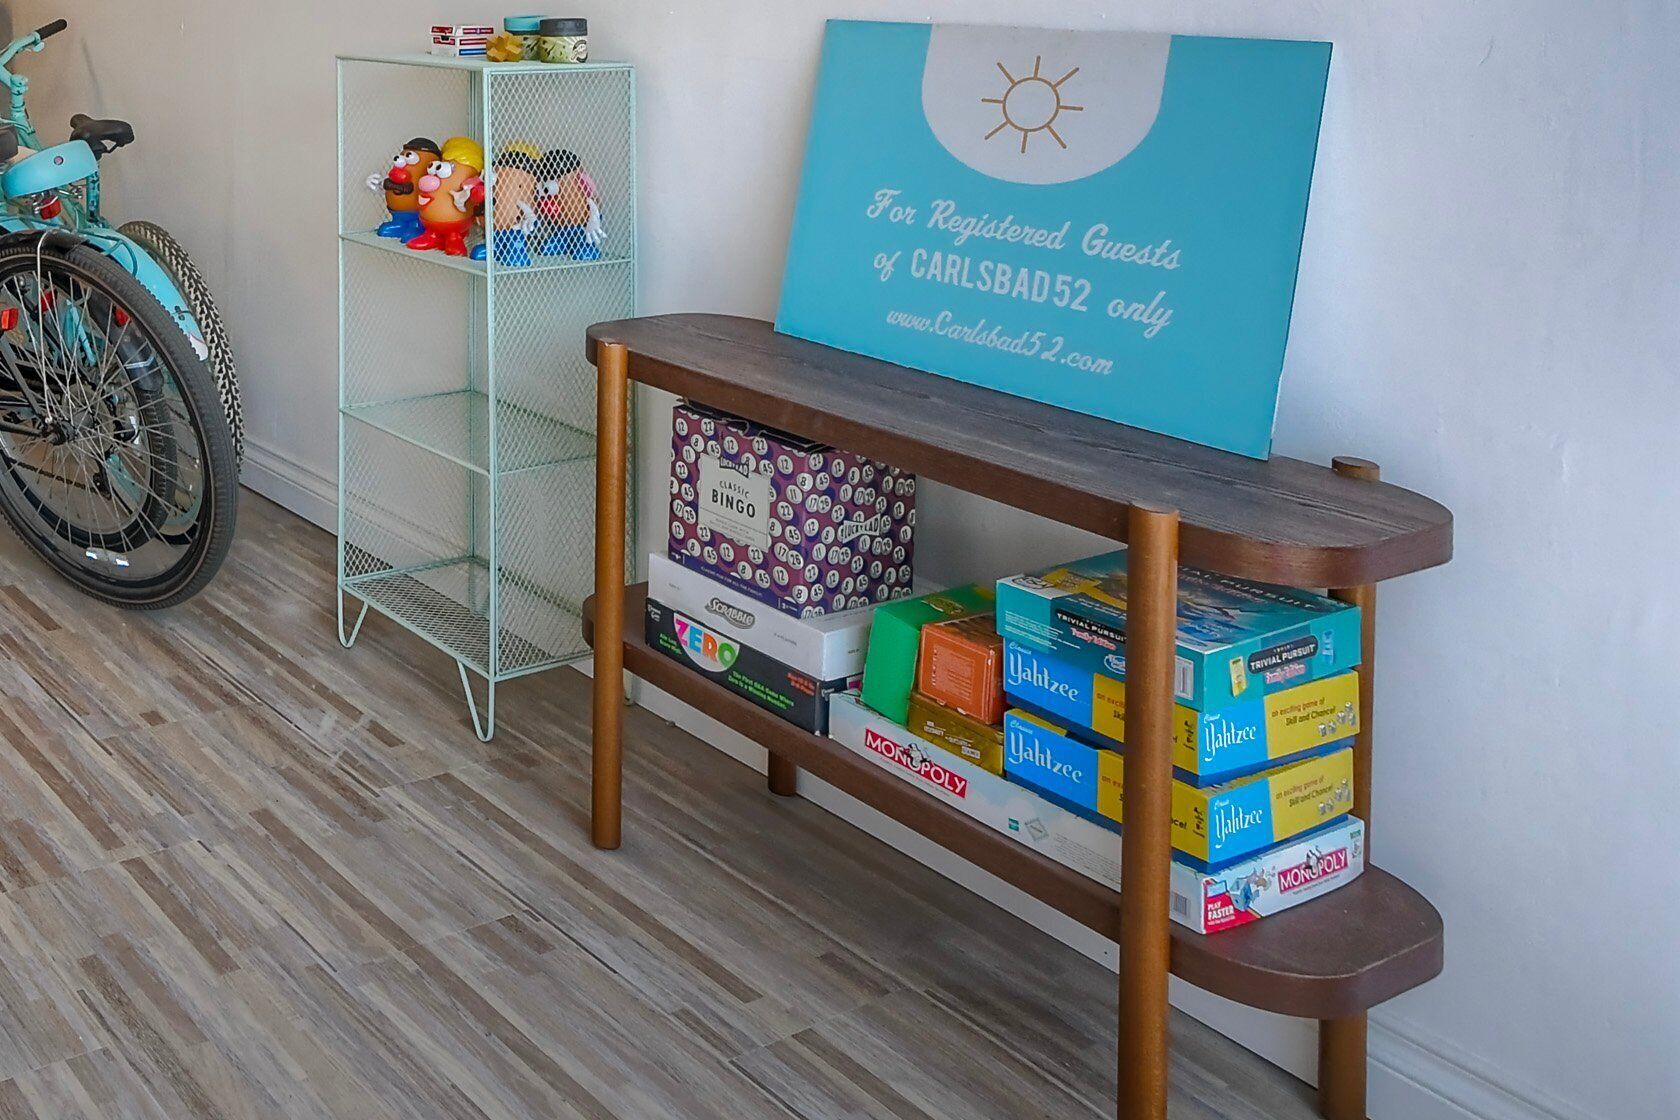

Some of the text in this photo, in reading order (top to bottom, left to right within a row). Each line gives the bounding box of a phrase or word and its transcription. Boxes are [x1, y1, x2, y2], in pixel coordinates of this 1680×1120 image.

[867, 188, 1181, 270] For Registered Guests
[873, 251, 902, 282] of
[1107, 290, 1174, 339] only
[886, 310, 1114, 375] www.Carlsbad52.com
[712, 489, 755, 518] BINGO
[720, 481, 750, 498] CLASSIC
[1057, 612, 1089, 630] TRIVIAL
[675, 618, 736, 668] ZERO
[1250, 656, 1281, 670] TRIVIAL
[1282, 644, 1316, 661] PURSUIT
[1008, 653, 1079, 702] Yahtzee
[1280, 705, 1302, 715] exciting
[1302, 700, 1318, 711] game
[1319, 696, 1325, 705] of
[1286, 706, 1336, 726] Skill and Chance!
[1008, 730, 1082, 784] Yahtzee
[1204, 719, 1256, 762] Yahtzee
[866, 731, 966, 794] MONOPOLY
[1283, 785, 1302, 796] exciting
[1304, 779, 1318, 790] game
[1301, 792, 1311, 802] and
[1215, 804, 1262, 849] Yahtzee
[1280, 849, 1346, 891] MONOPOLY
[1207, 901, 1221, 911] PLAY
[1208, 905, 1234, 921] FASTER
